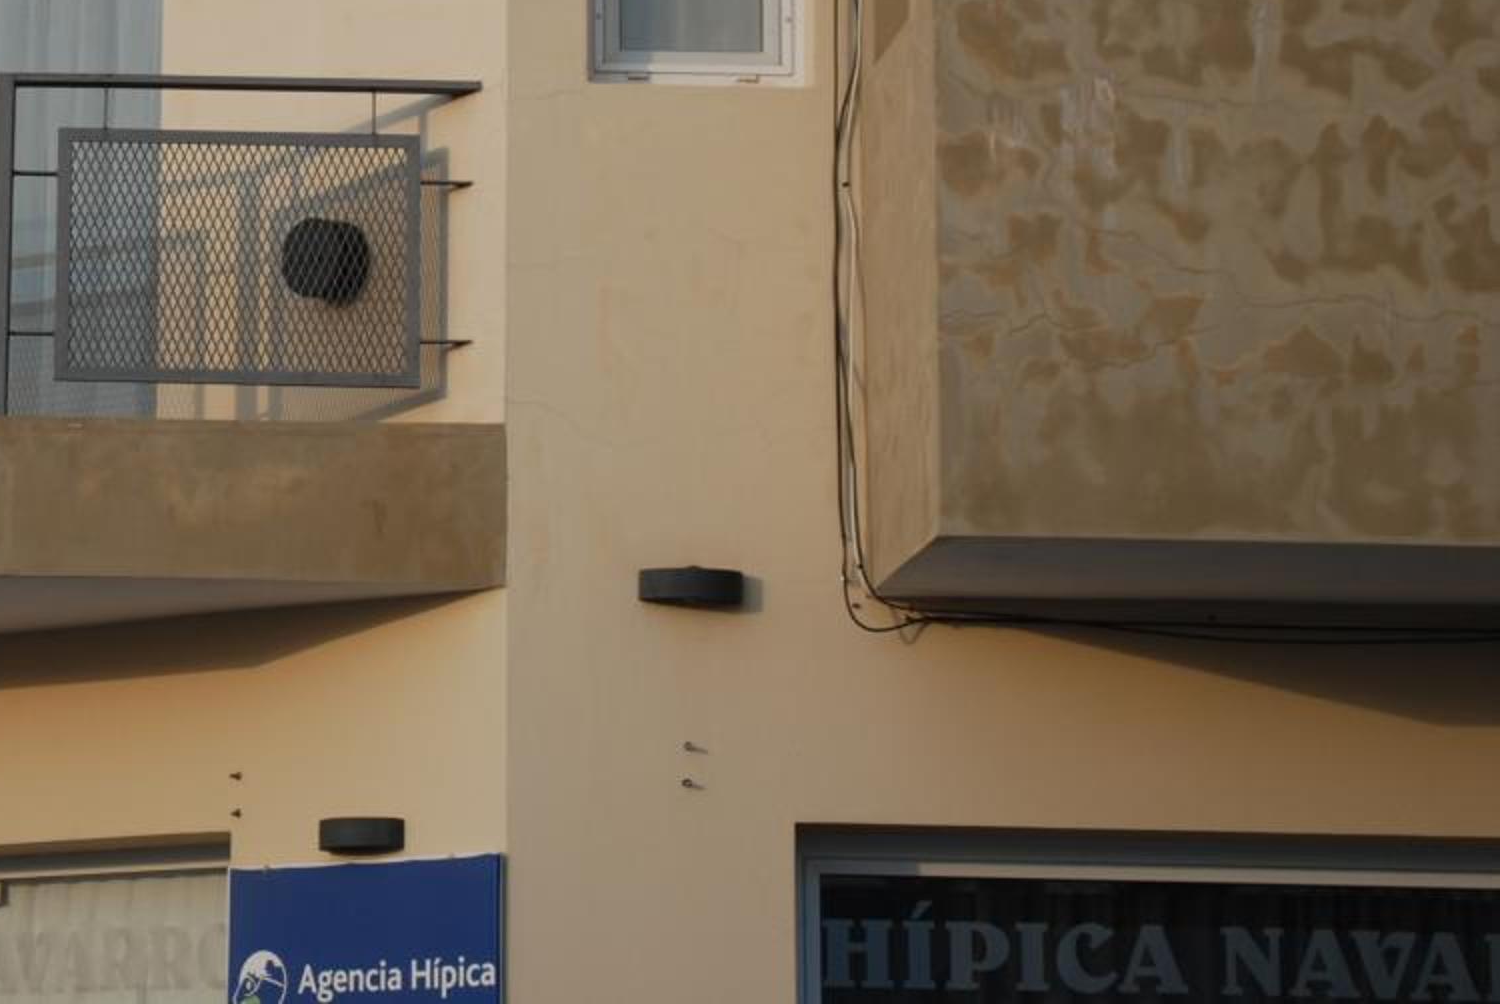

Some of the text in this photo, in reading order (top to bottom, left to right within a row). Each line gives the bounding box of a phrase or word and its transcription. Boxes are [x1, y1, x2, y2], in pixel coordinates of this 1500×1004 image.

[298, 956, 496, 1003] Agencia Hípica
[821, 899, 1500, 1002] HÍPICA NAVA
